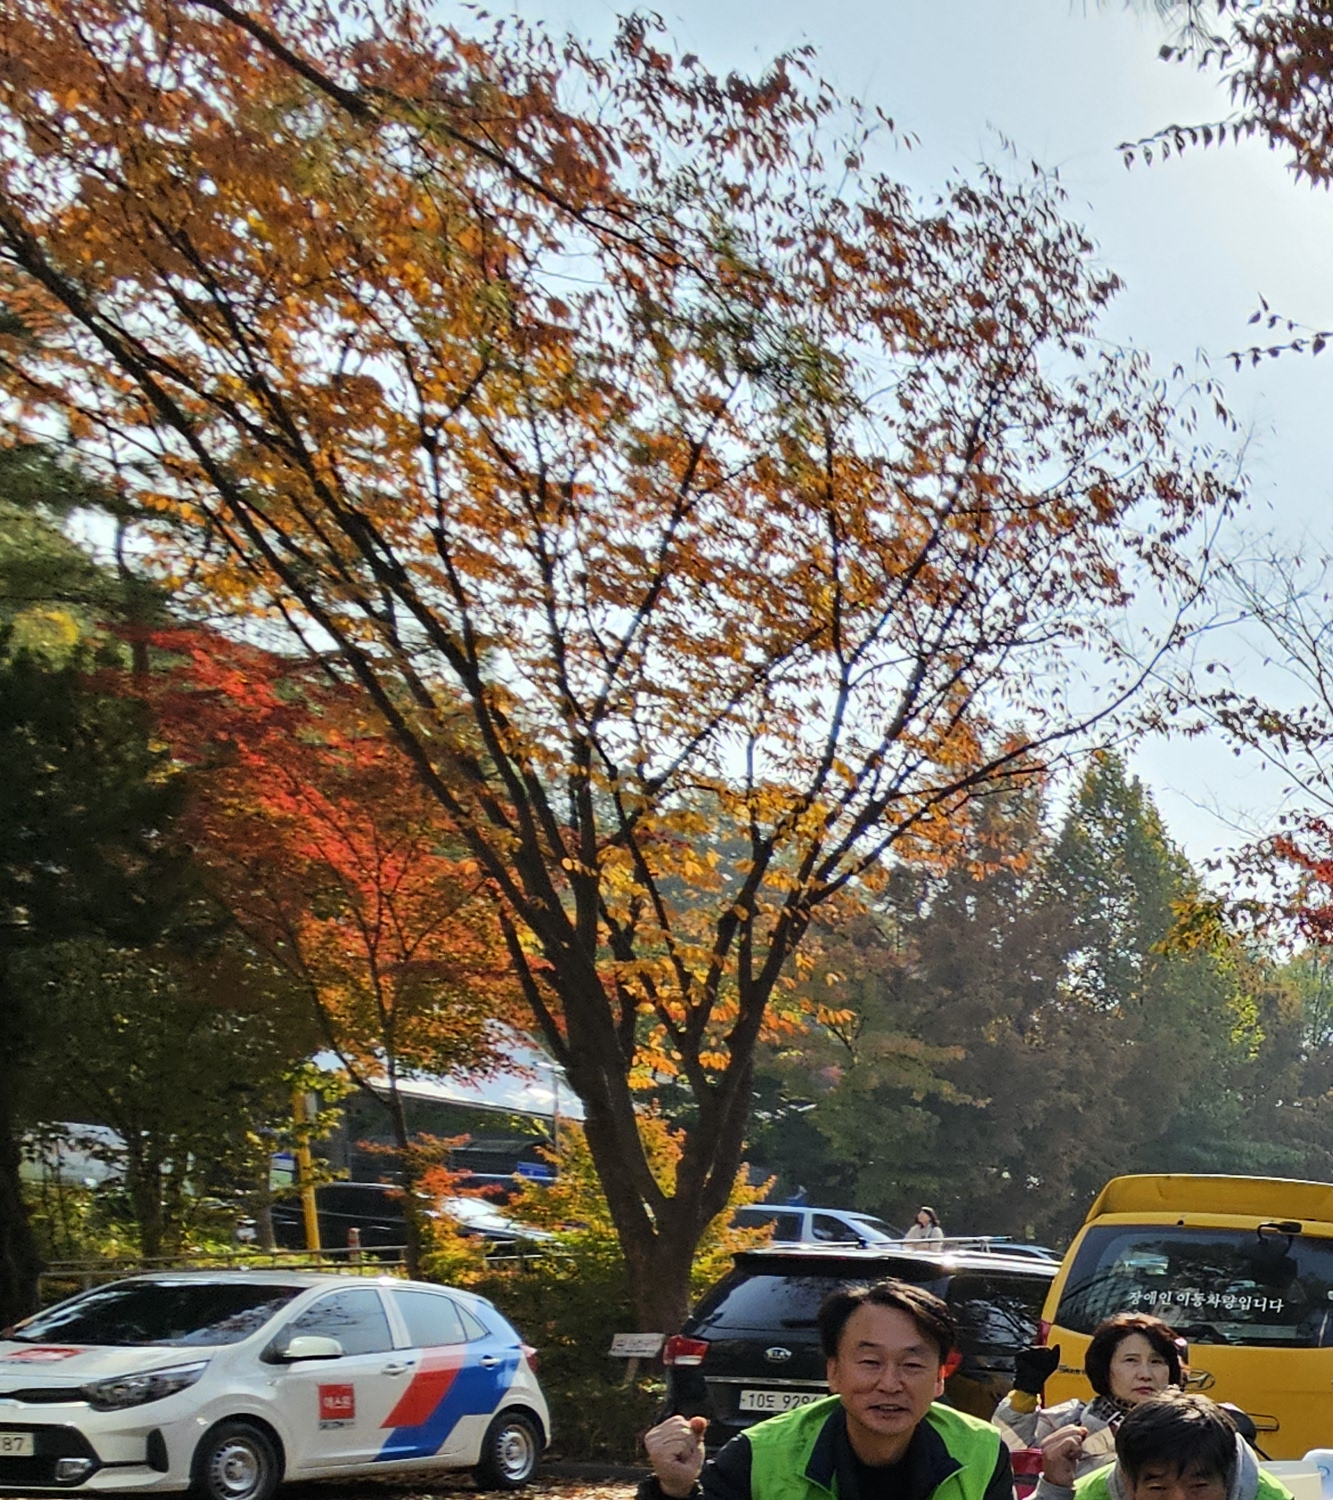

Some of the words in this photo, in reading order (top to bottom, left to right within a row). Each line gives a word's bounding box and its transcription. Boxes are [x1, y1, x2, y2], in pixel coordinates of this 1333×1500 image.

[1129, 1290, 1171, 1306] 장애인
[1176, 1291, 1284, 1313] 이동차량입니다
[748, 1394, 776, 1408] 10도
